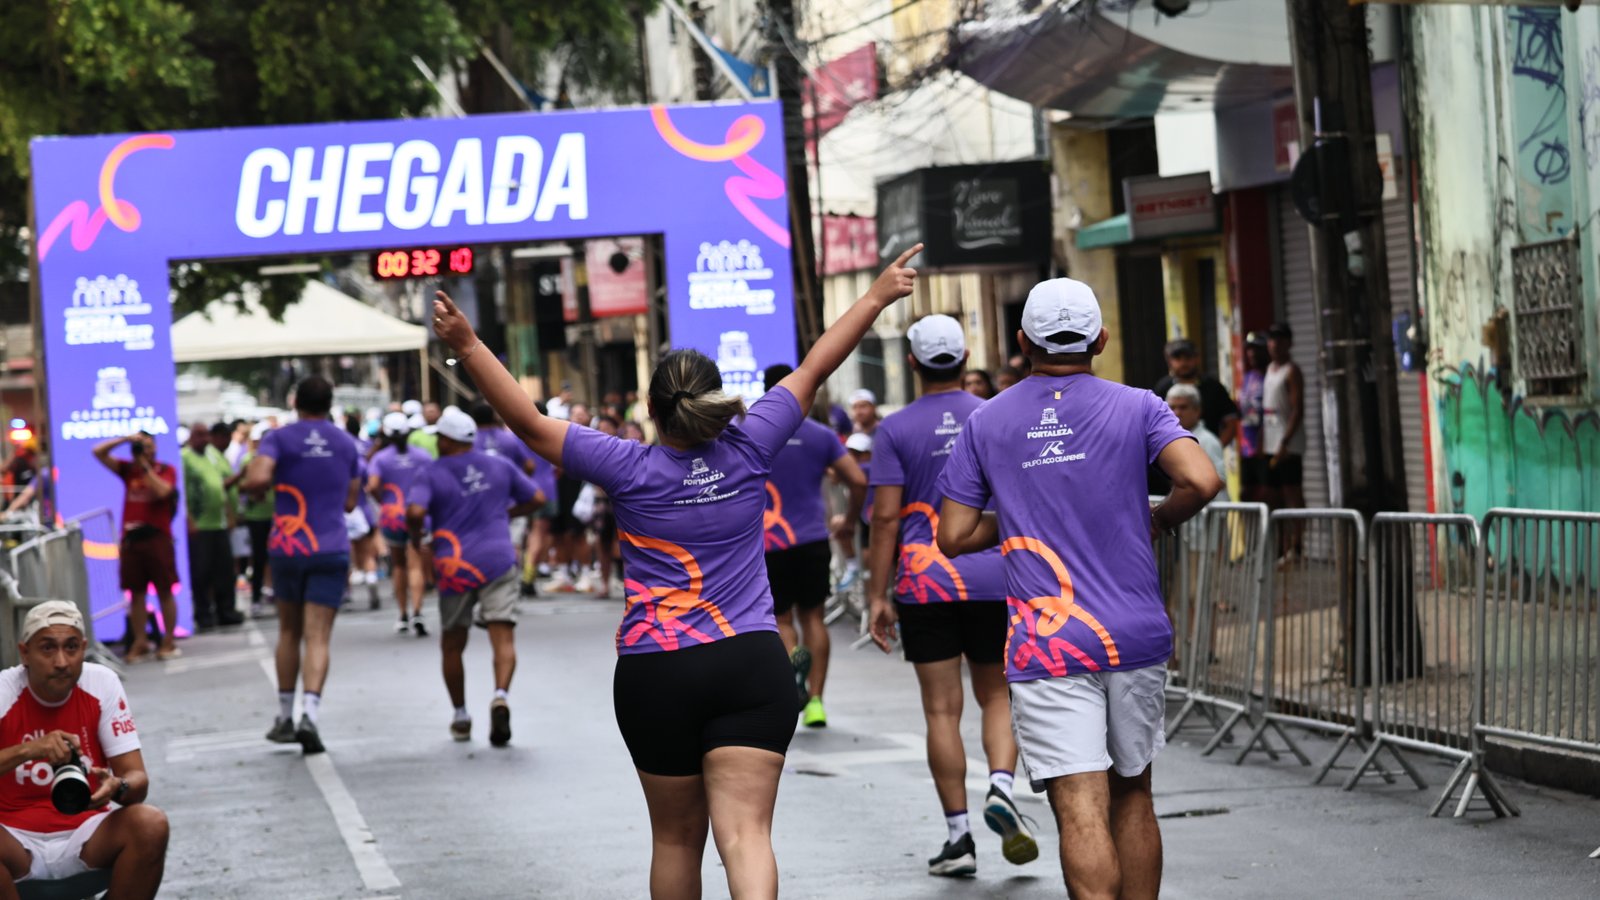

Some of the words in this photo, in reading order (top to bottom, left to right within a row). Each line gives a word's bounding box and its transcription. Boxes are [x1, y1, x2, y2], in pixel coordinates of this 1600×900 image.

[236, 132, 589, 238] CHEGADA
[377, 251, 409, 277] 00
[411, 249, 440, 275] 32
[450, 247, 472, 273] 10
[1027, 428, 1074, 439] FORTALEZA
[1022, 459, 1041, 469] GRUPO
[1055, 453, 1086, 463] CEARENSE
[683, 472, 725, 486] FORTALEZA
